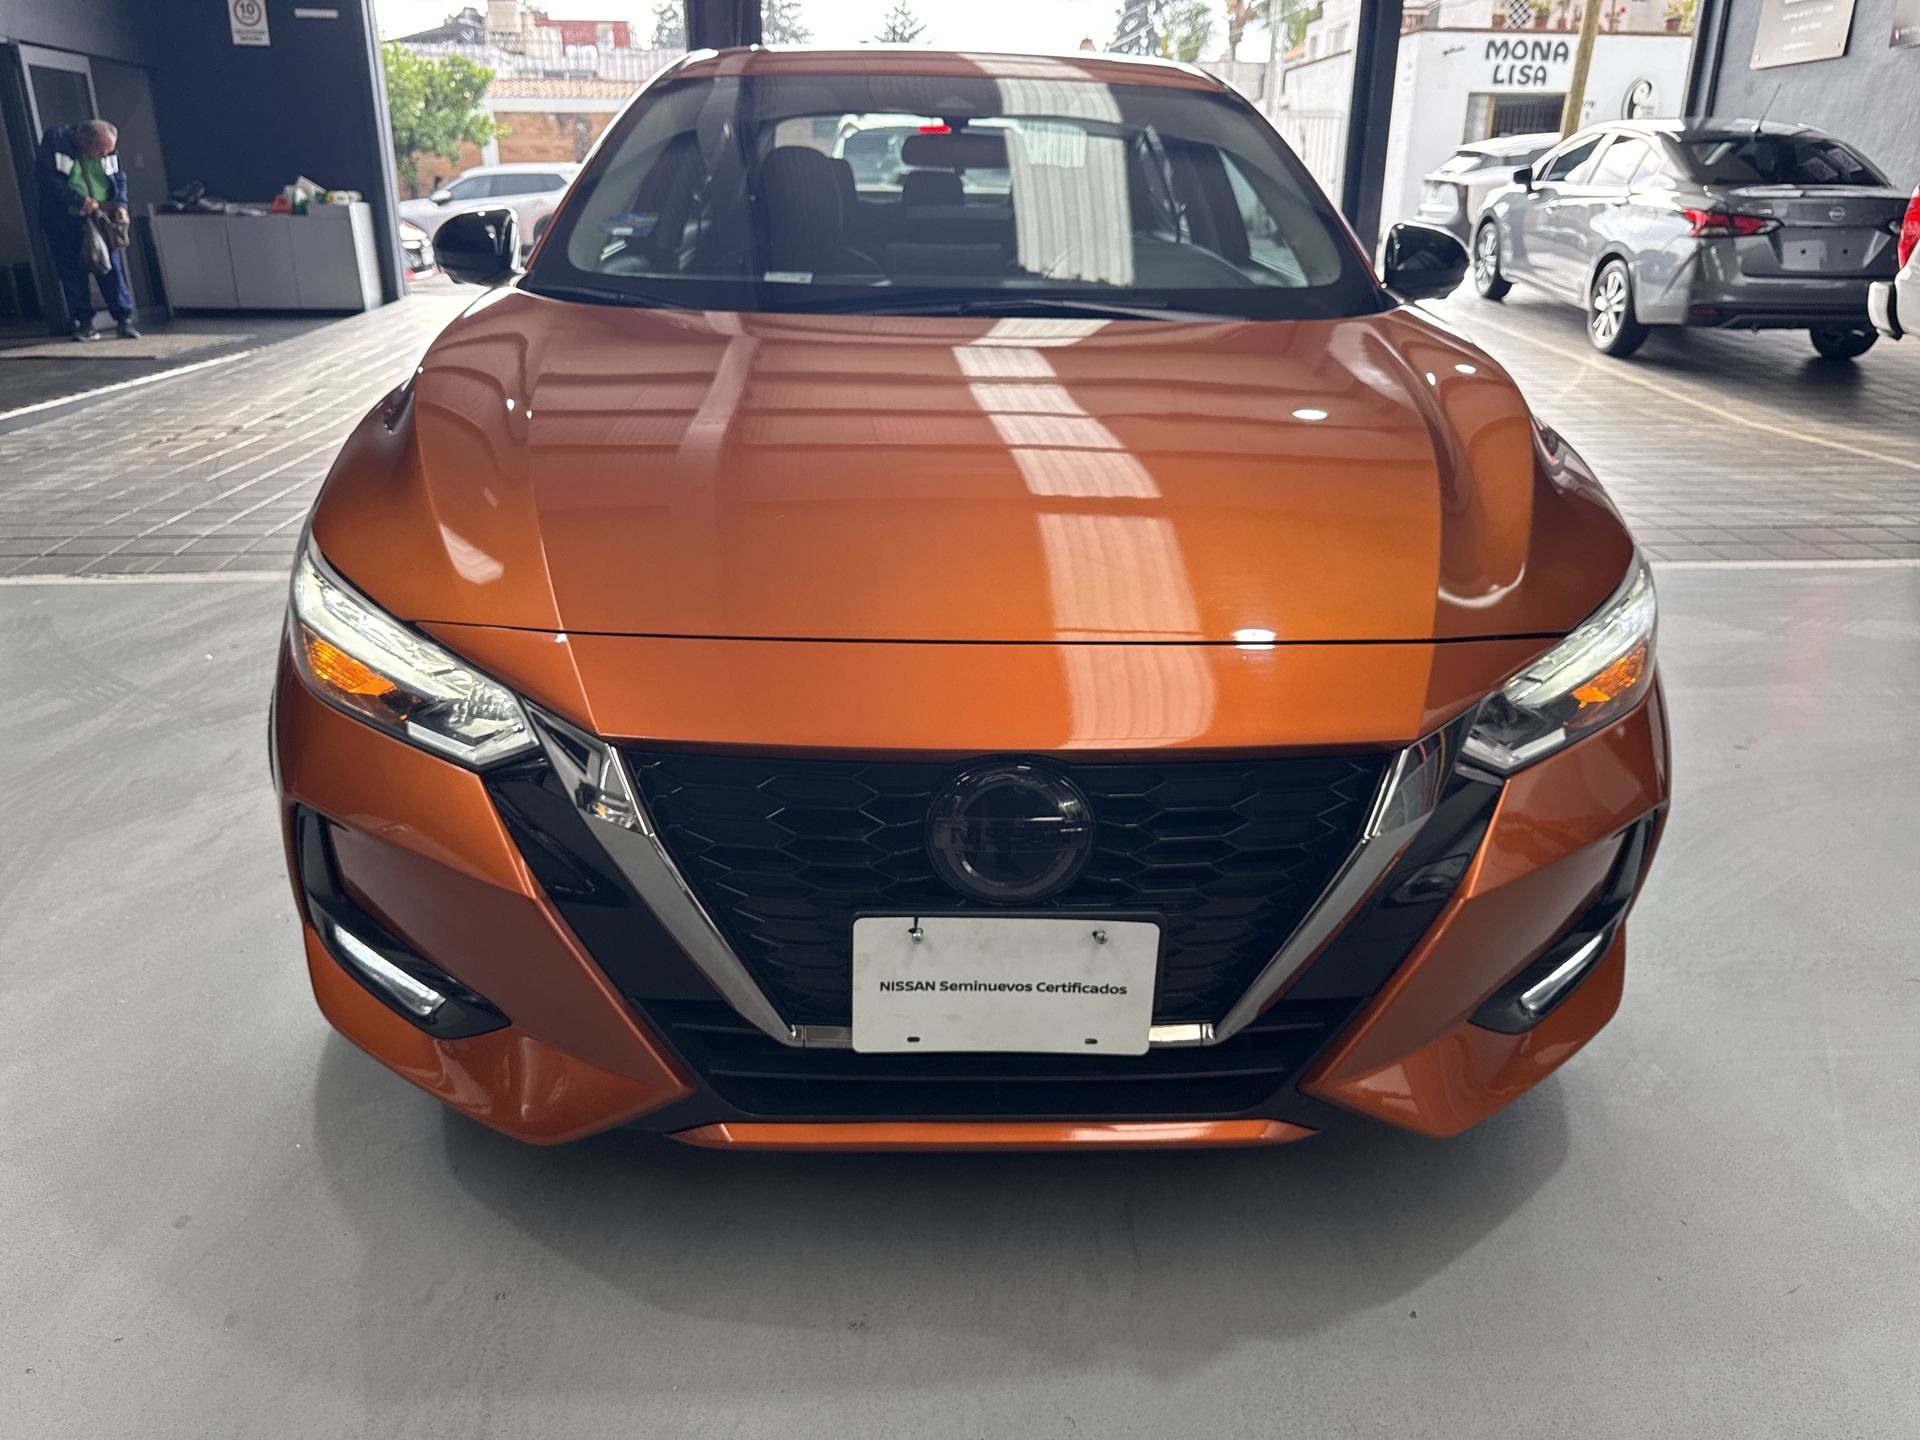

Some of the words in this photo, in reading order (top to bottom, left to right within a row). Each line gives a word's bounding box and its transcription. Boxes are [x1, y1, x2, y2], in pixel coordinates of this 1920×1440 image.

[240, 2, 255, 16] 10
[1485, 39, 1570, 62] MONA
[1492, 65, 1548, 85] LISA
[879, 980, 936, 992] NISSAN
[939, 980, 1033, 993] Seminuevos
[1036, 981, 1128, 996] Certificados
